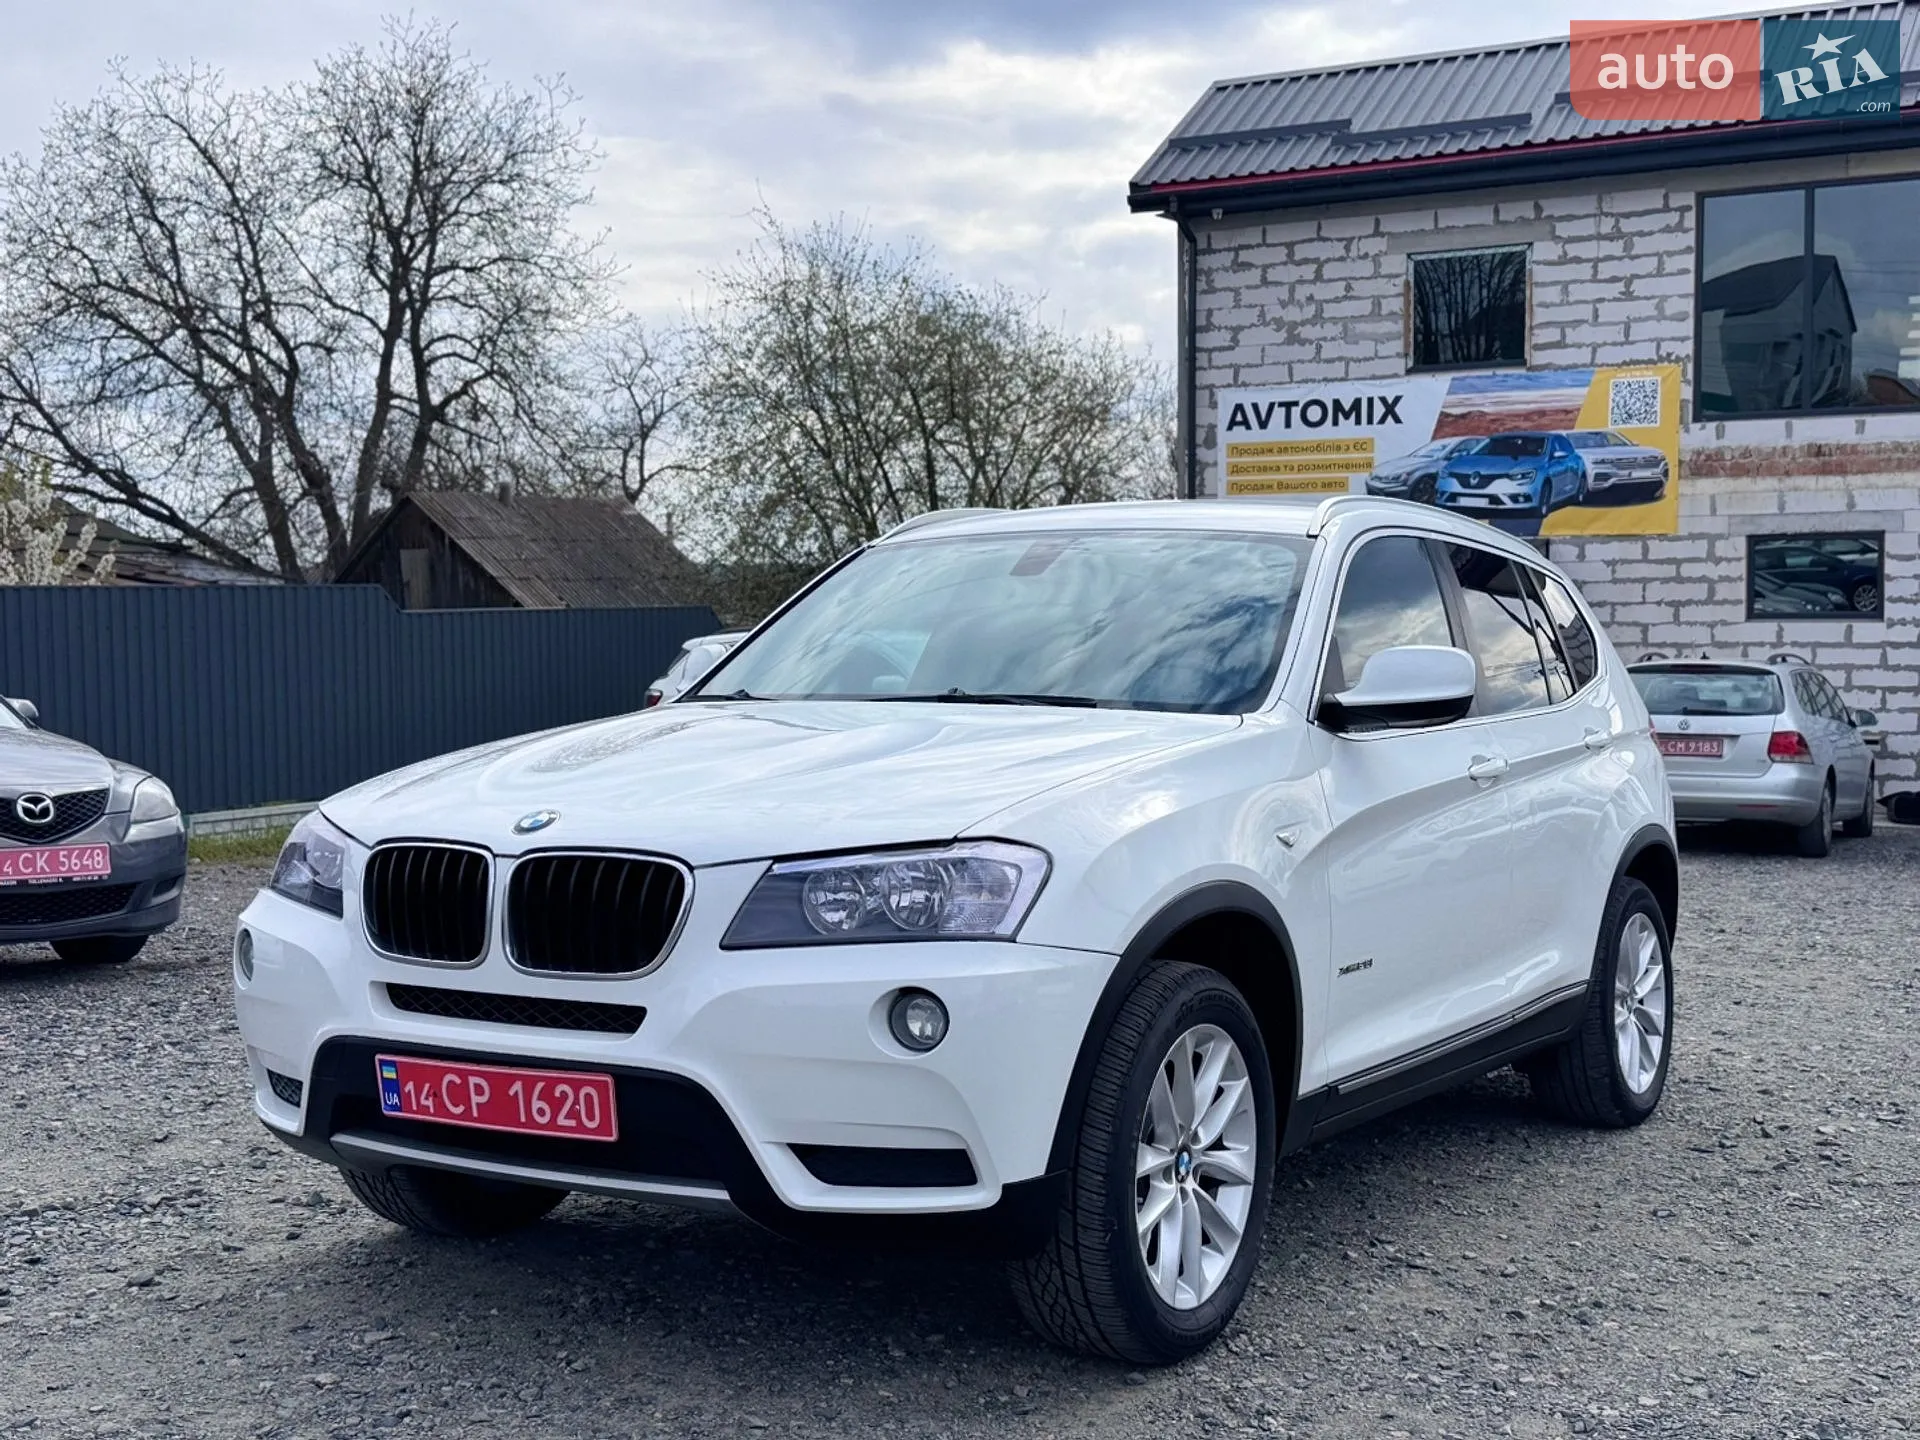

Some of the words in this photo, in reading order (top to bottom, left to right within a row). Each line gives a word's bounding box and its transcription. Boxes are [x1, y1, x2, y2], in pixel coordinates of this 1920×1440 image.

[1226, 394, 1404, 432] AVTOMIX
[1230, 446, 1274, 457] Продаж
[1276, 442, 1341, 455] автомобілів
[1353, 441, 1368, 452] ЄС
[1230, 464, 1281, 476] Доставка
[1283, 463, 1295, 472] та
[1297, 461, 1373, 473] розмитнення
[1230, 482, 1274, 493] Продаж
[1276, 480, 1318, 491] Вашого
[1321, 481, 1346, 490] авто
[59, 848, 104, 872] 5648
[384, 1091, 400, 1106] UA
[507, 1079, 601, 1130] 1620
